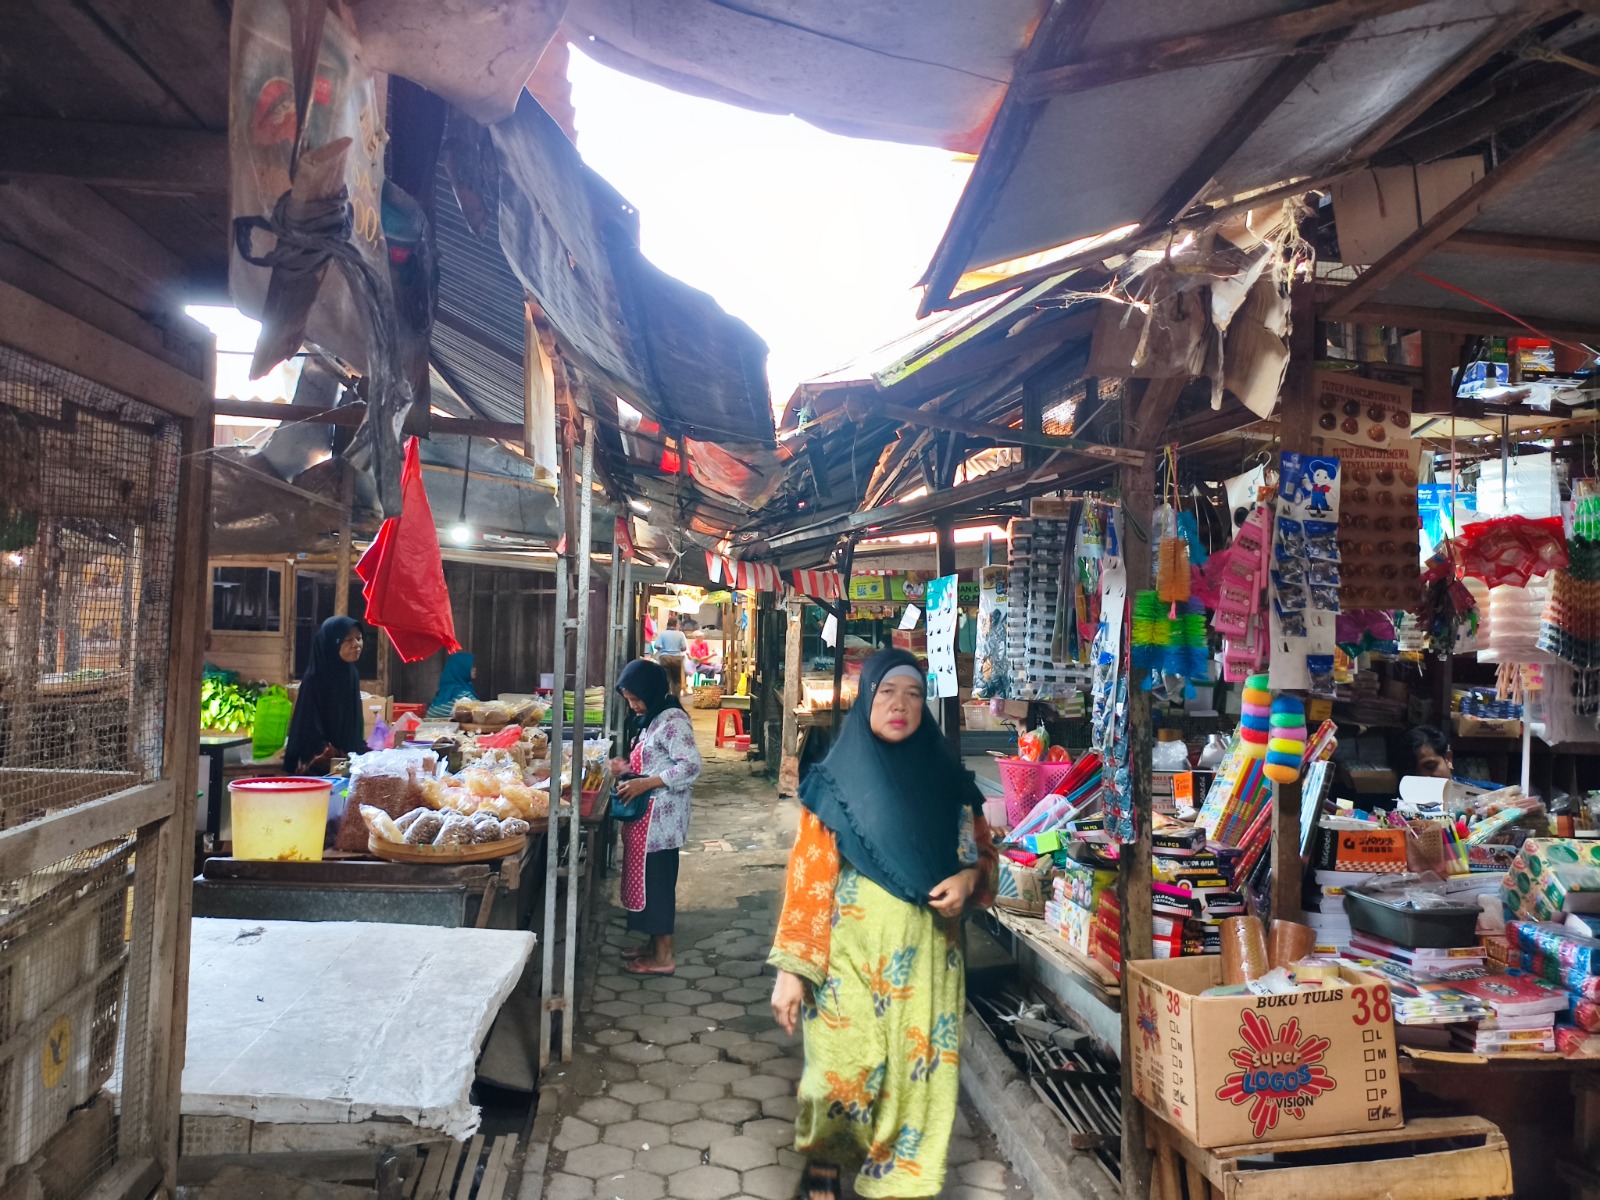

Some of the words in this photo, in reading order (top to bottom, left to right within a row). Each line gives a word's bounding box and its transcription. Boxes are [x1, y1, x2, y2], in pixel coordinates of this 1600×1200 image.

[1322, 381, 1344, 394] TUTUP
[1345, 384, 1367, 398] PANCI
[1368, 388, 1402, 405] ISTIMEWA
[1332, 448, 1354, 458] TUTUP
[1355, 448, 1375, 459] PANCI
[1377, 449, 1409, 459] ISTIMEWA
[1166, 990, 1181, 1017] 38
[1256, 994, 1298, 1009] BUKU
[1302, 989, 1344, 1005] TULIS
[1351, 984, 1391, 1026] 38
[1376, 1030, 1382, 1040] L
[1251, 1051, 1302, 1068] super
[1378, 1049, 1387, 1059] M
[1243, 1064, 1312, 1094] LOGOS
[1379, 1069, 1387, 1079] D
[1380, 1088, 1388, 1099] P
[1275, 1095, 1315, 1109] VISION
